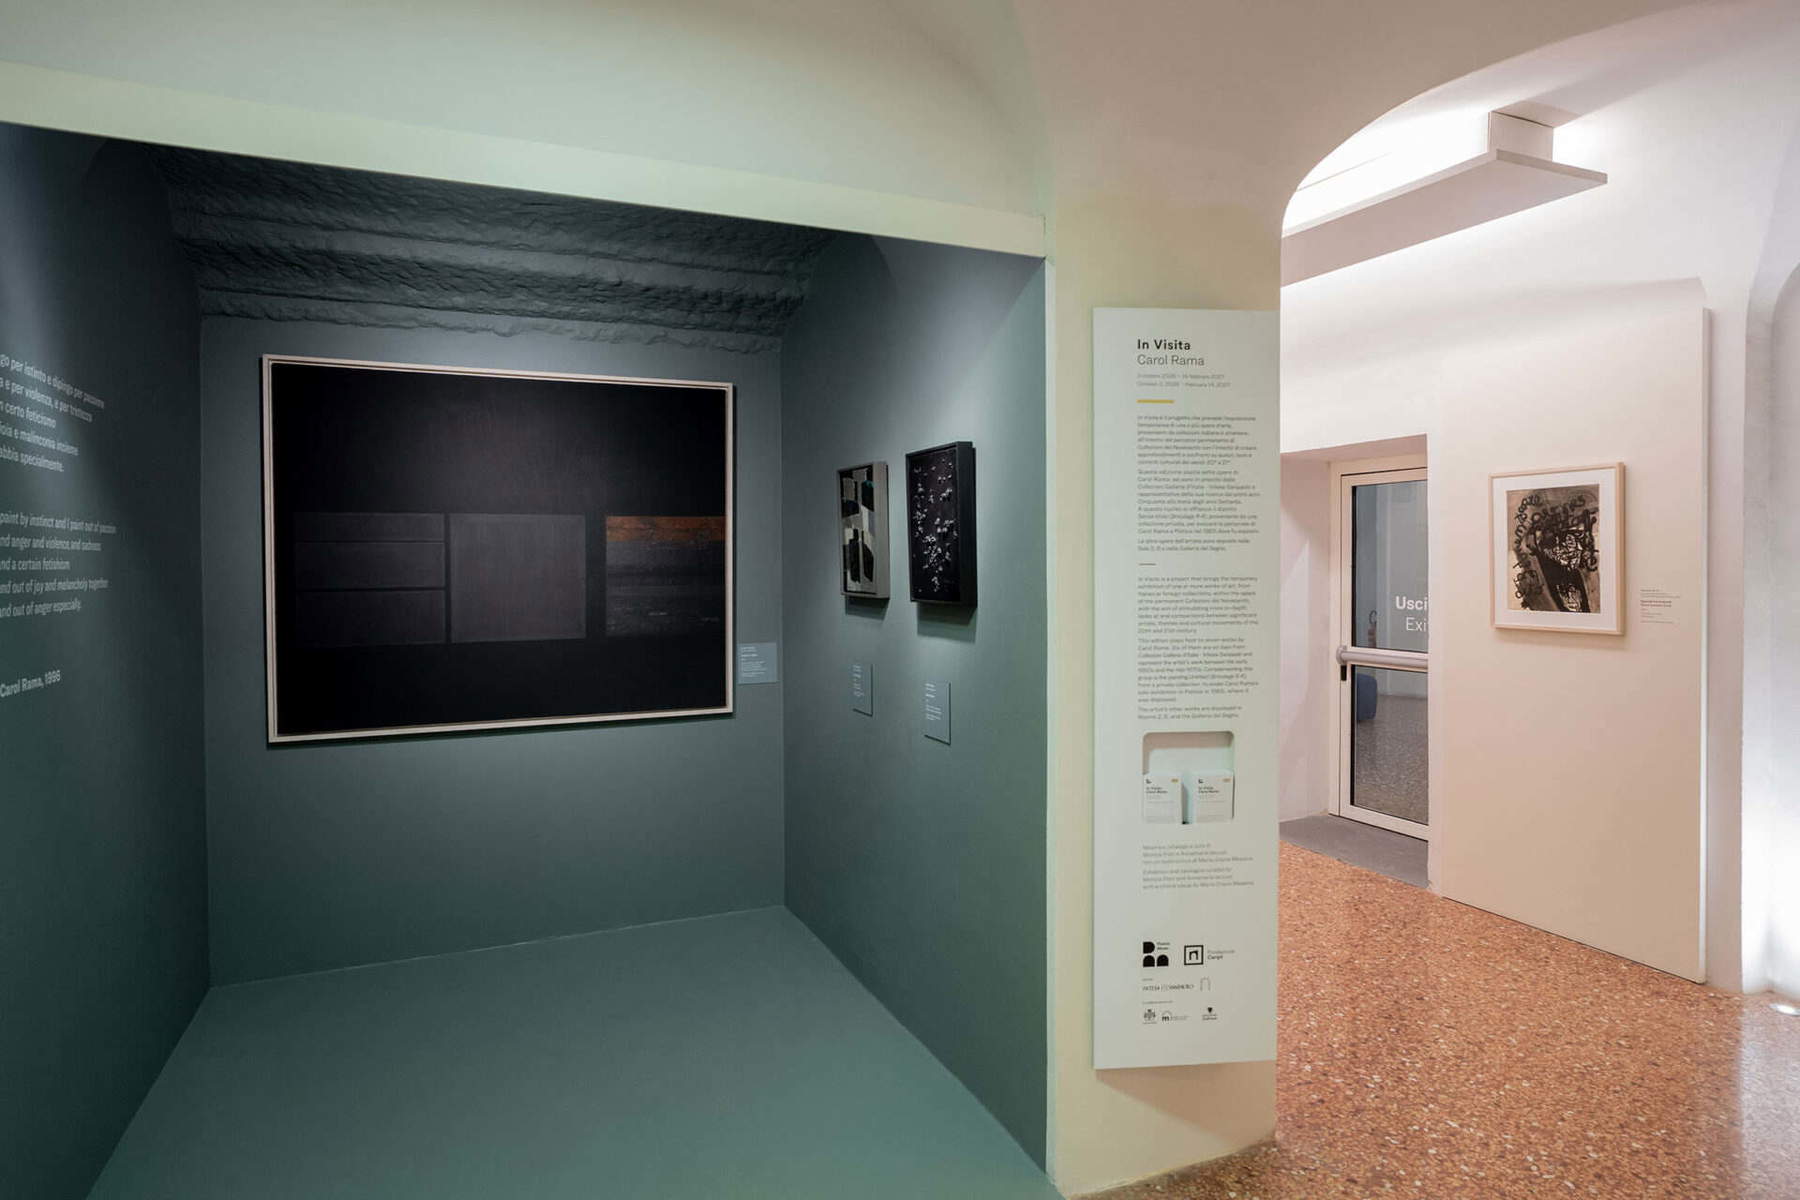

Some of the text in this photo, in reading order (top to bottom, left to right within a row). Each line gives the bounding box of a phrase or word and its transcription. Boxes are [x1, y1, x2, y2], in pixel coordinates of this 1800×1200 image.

[1137, 339, 1192, 350] In Visita
[1137, 354, 1205, 366] Carol Rama
